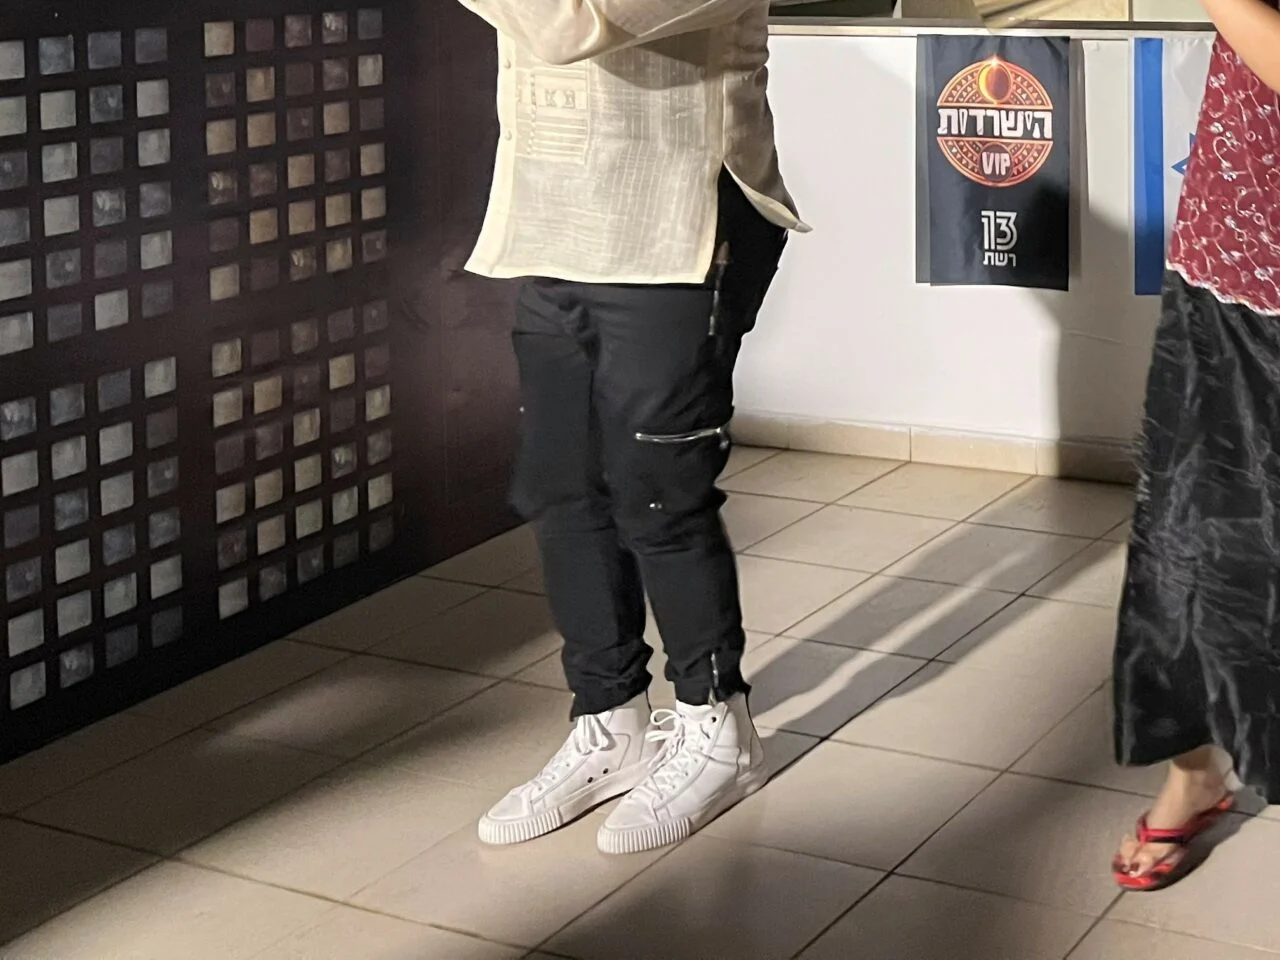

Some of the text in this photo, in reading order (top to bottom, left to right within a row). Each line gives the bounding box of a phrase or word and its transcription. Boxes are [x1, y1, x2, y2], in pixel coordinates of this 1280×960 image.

[937, 108, 1052, 139] הישרדות
[981, 151, 1011, 175] VIP
[981, 210, 1018, 251] 13
[983, 252, 1017, 267] רשת
